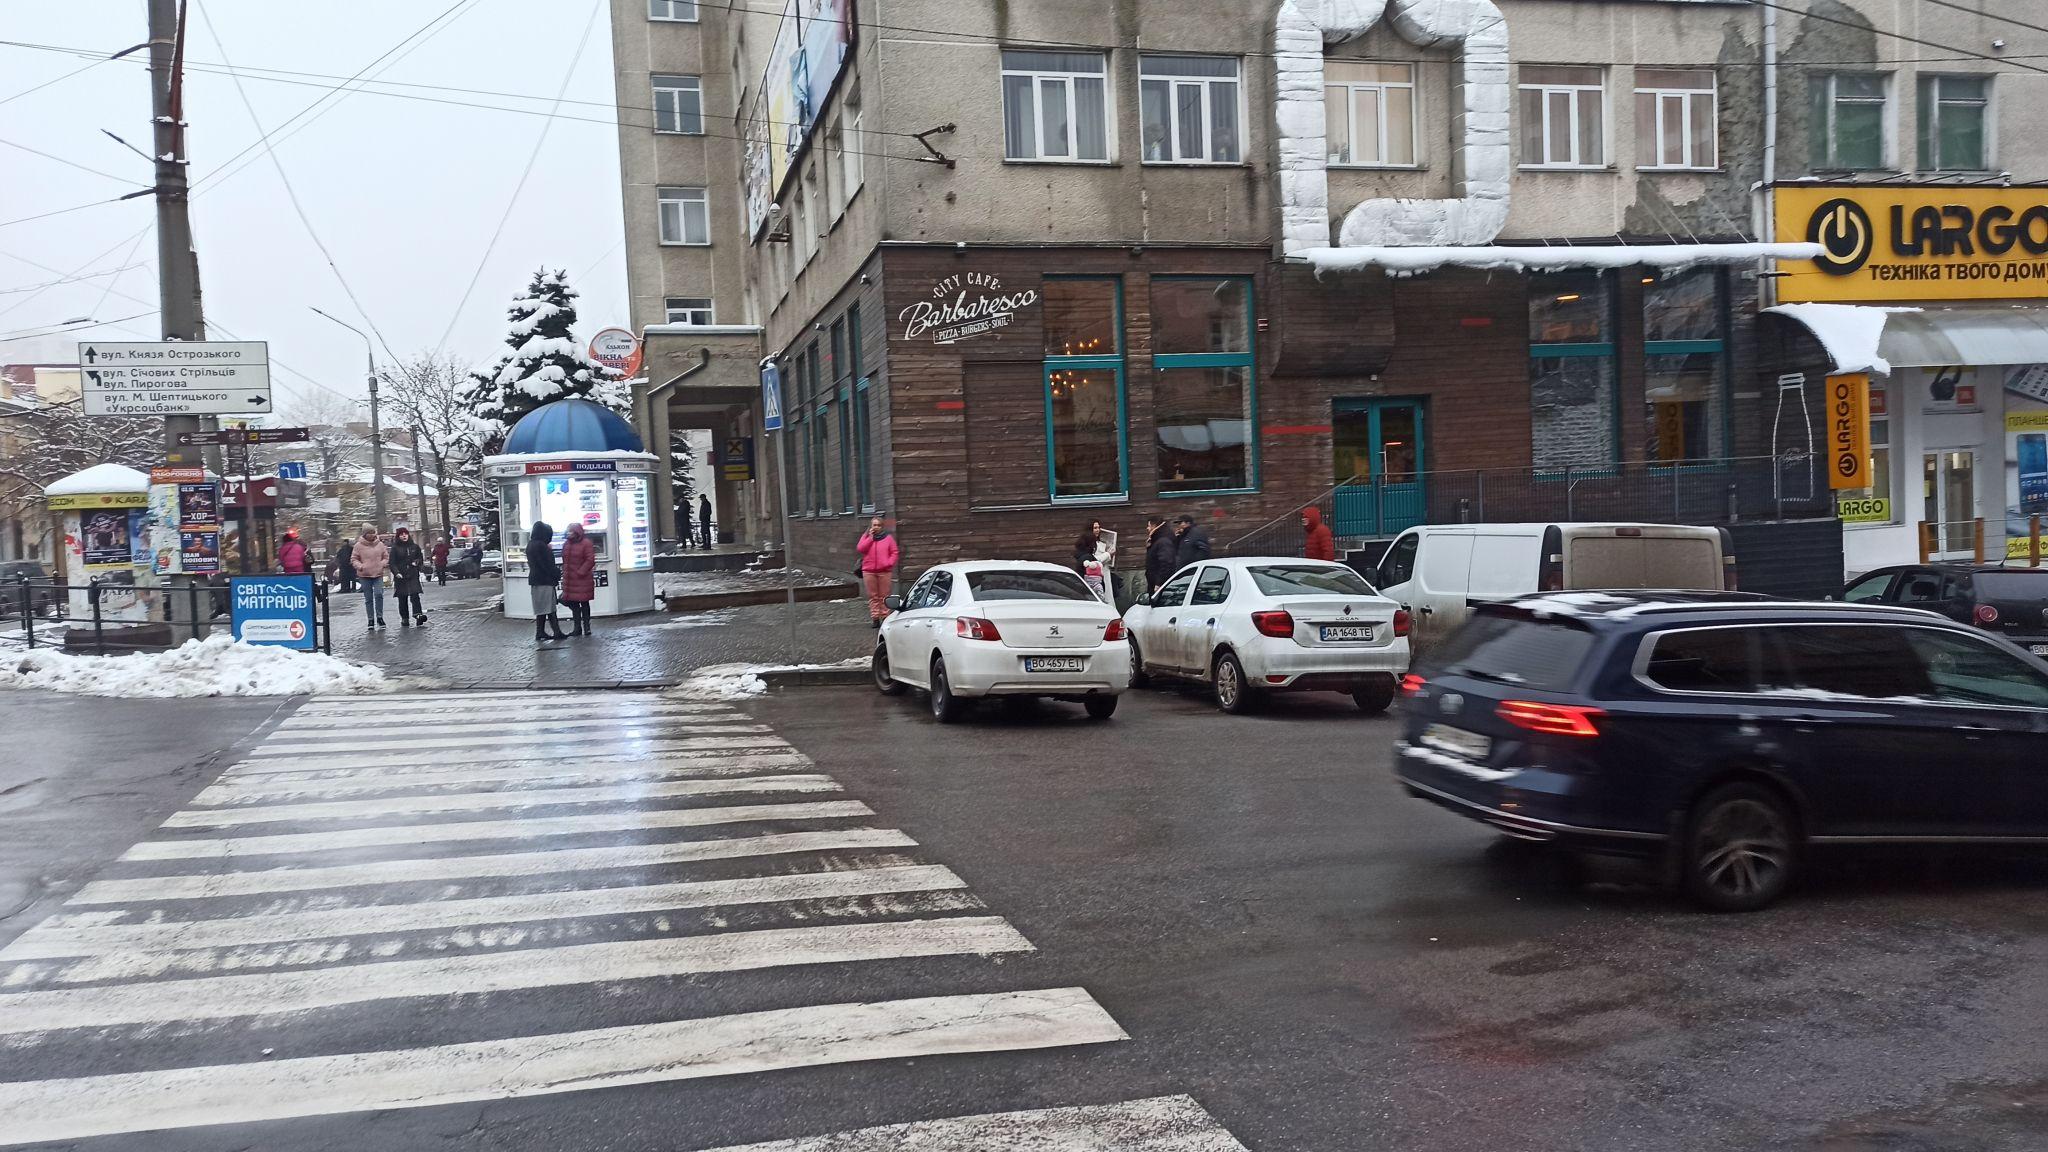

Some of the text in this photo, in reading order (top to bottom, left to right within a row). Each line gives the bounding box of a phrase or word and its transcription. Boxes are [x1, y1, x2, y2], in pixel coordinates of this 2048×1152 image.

[1890, 204, 2048, 257] LARGO
[1869, 261, 2048, 282] техніка твого дом
[899, 289, 1037, 340] Barbaresco
[101, 349, 241, 359] вул. Князя Острозького
[103, 368, 236, 378] вул. Січових Стрільців
[104, 379, 187, 389] вул. Пирогова
[104, 392, 228, 402] вул. М. Шептицького
[1836, 383, 1851, 452] LARGO
[576, 462, 612, 470] ПОДІЛЛЯ
[190, 512, 208, 520] ХОР
[237, 584, 267, 595] СВІТ
[237, 595, 308, 611] МАТРАЦІВ
[1340, 628, 1357, 637] 1648
[1359, 628, 1371, 637] TE
[1047, 659, 1066, 668] 4657
